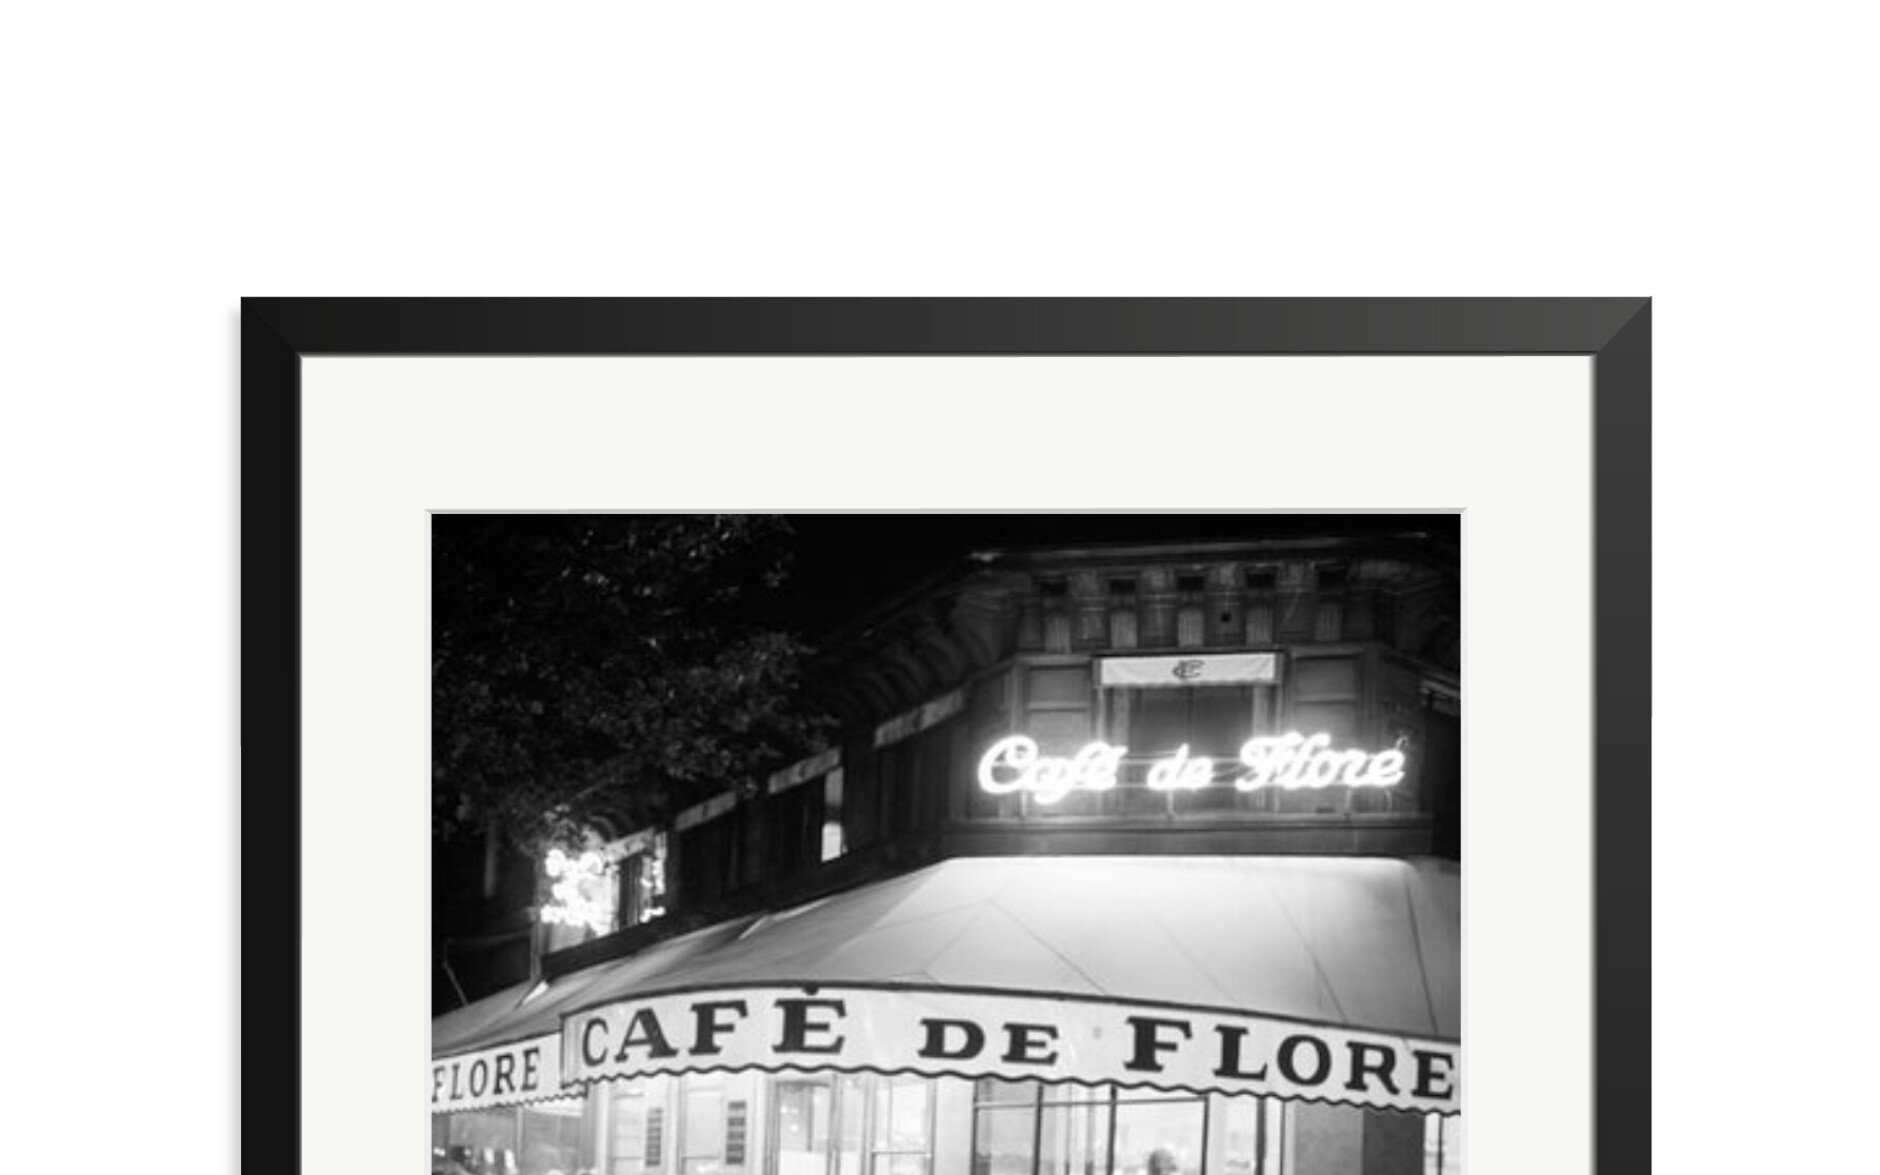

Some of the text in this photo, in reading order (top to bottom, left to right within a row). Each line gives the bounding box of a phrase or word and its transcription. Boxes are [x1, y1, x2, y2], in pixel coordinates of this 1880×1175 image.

[1146, 743, 1213, 792] de
[1235, 732, 1404, 791] Flore
[432, 1047, 541, 1102] FLORE
[917, 998, 1059, 1066] DE
[1123, 1015, 1455, 1100] FLORE
